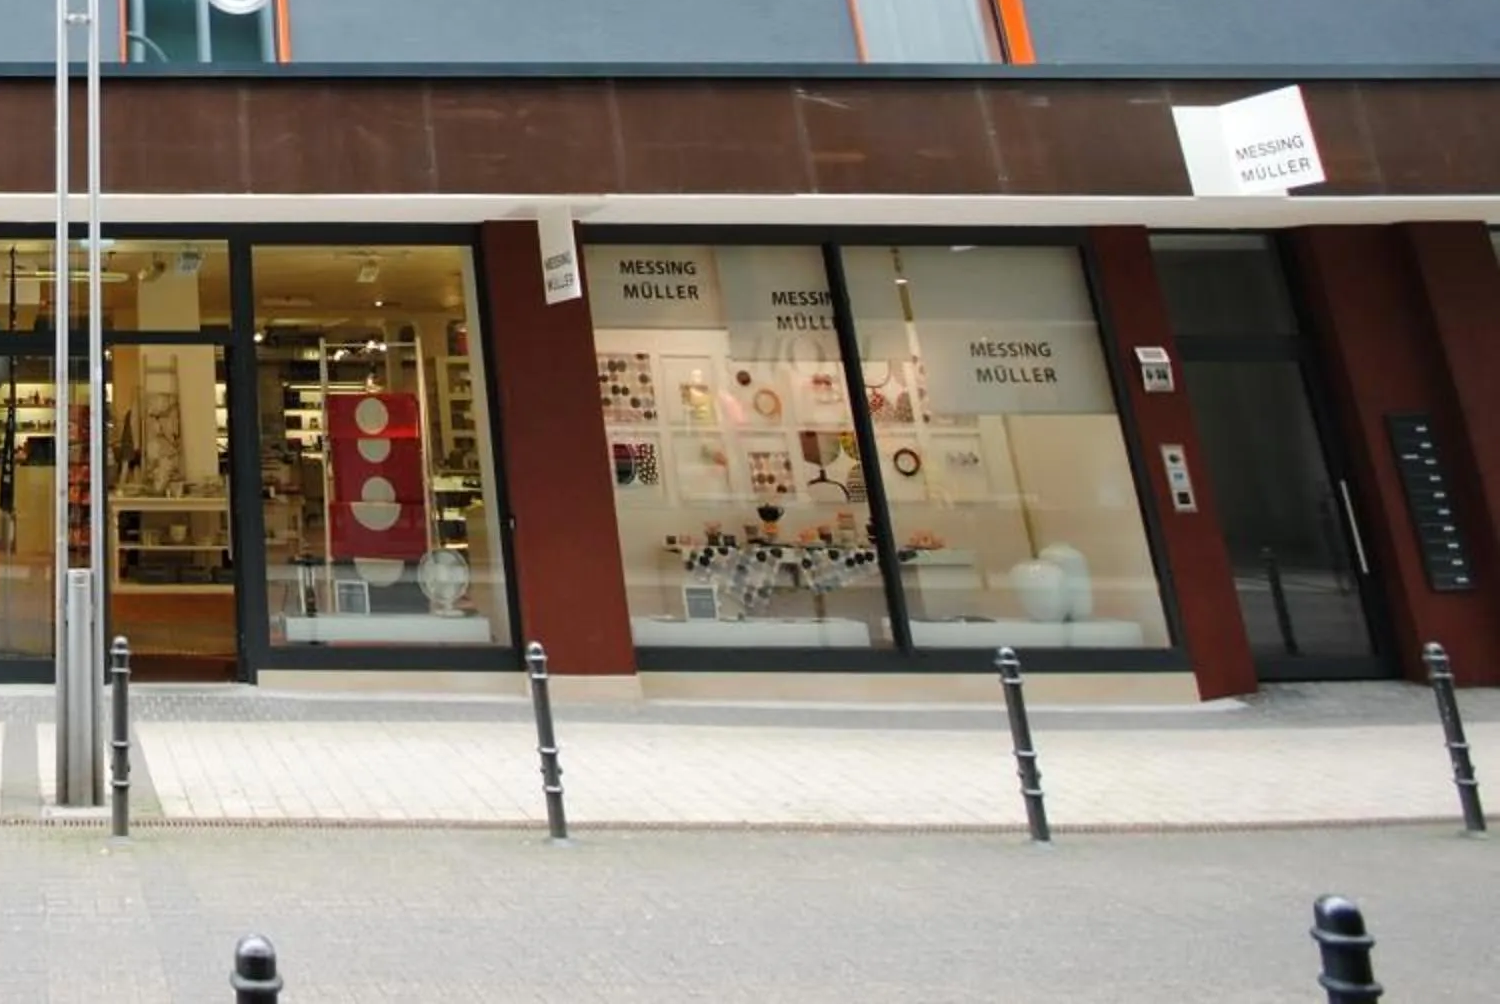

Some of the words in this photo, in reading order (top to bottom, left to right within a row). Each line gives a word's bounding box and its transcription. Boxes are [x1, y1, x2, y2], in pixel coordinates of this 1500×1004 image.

[1235, 134, 1304, 160] MESSING
[1241, 157, 1311, 182] MÜLLER
[619, 259, 697, 275] MESSING
[623, 281, 699, 300] MÜLLER
[771, 291, 832, 306] MESSI
[776, 312, 832, 330] MÜLL
[969, 341, 1052, 357] MESSING
[975, 365, 1057, 383] MÜLLER
